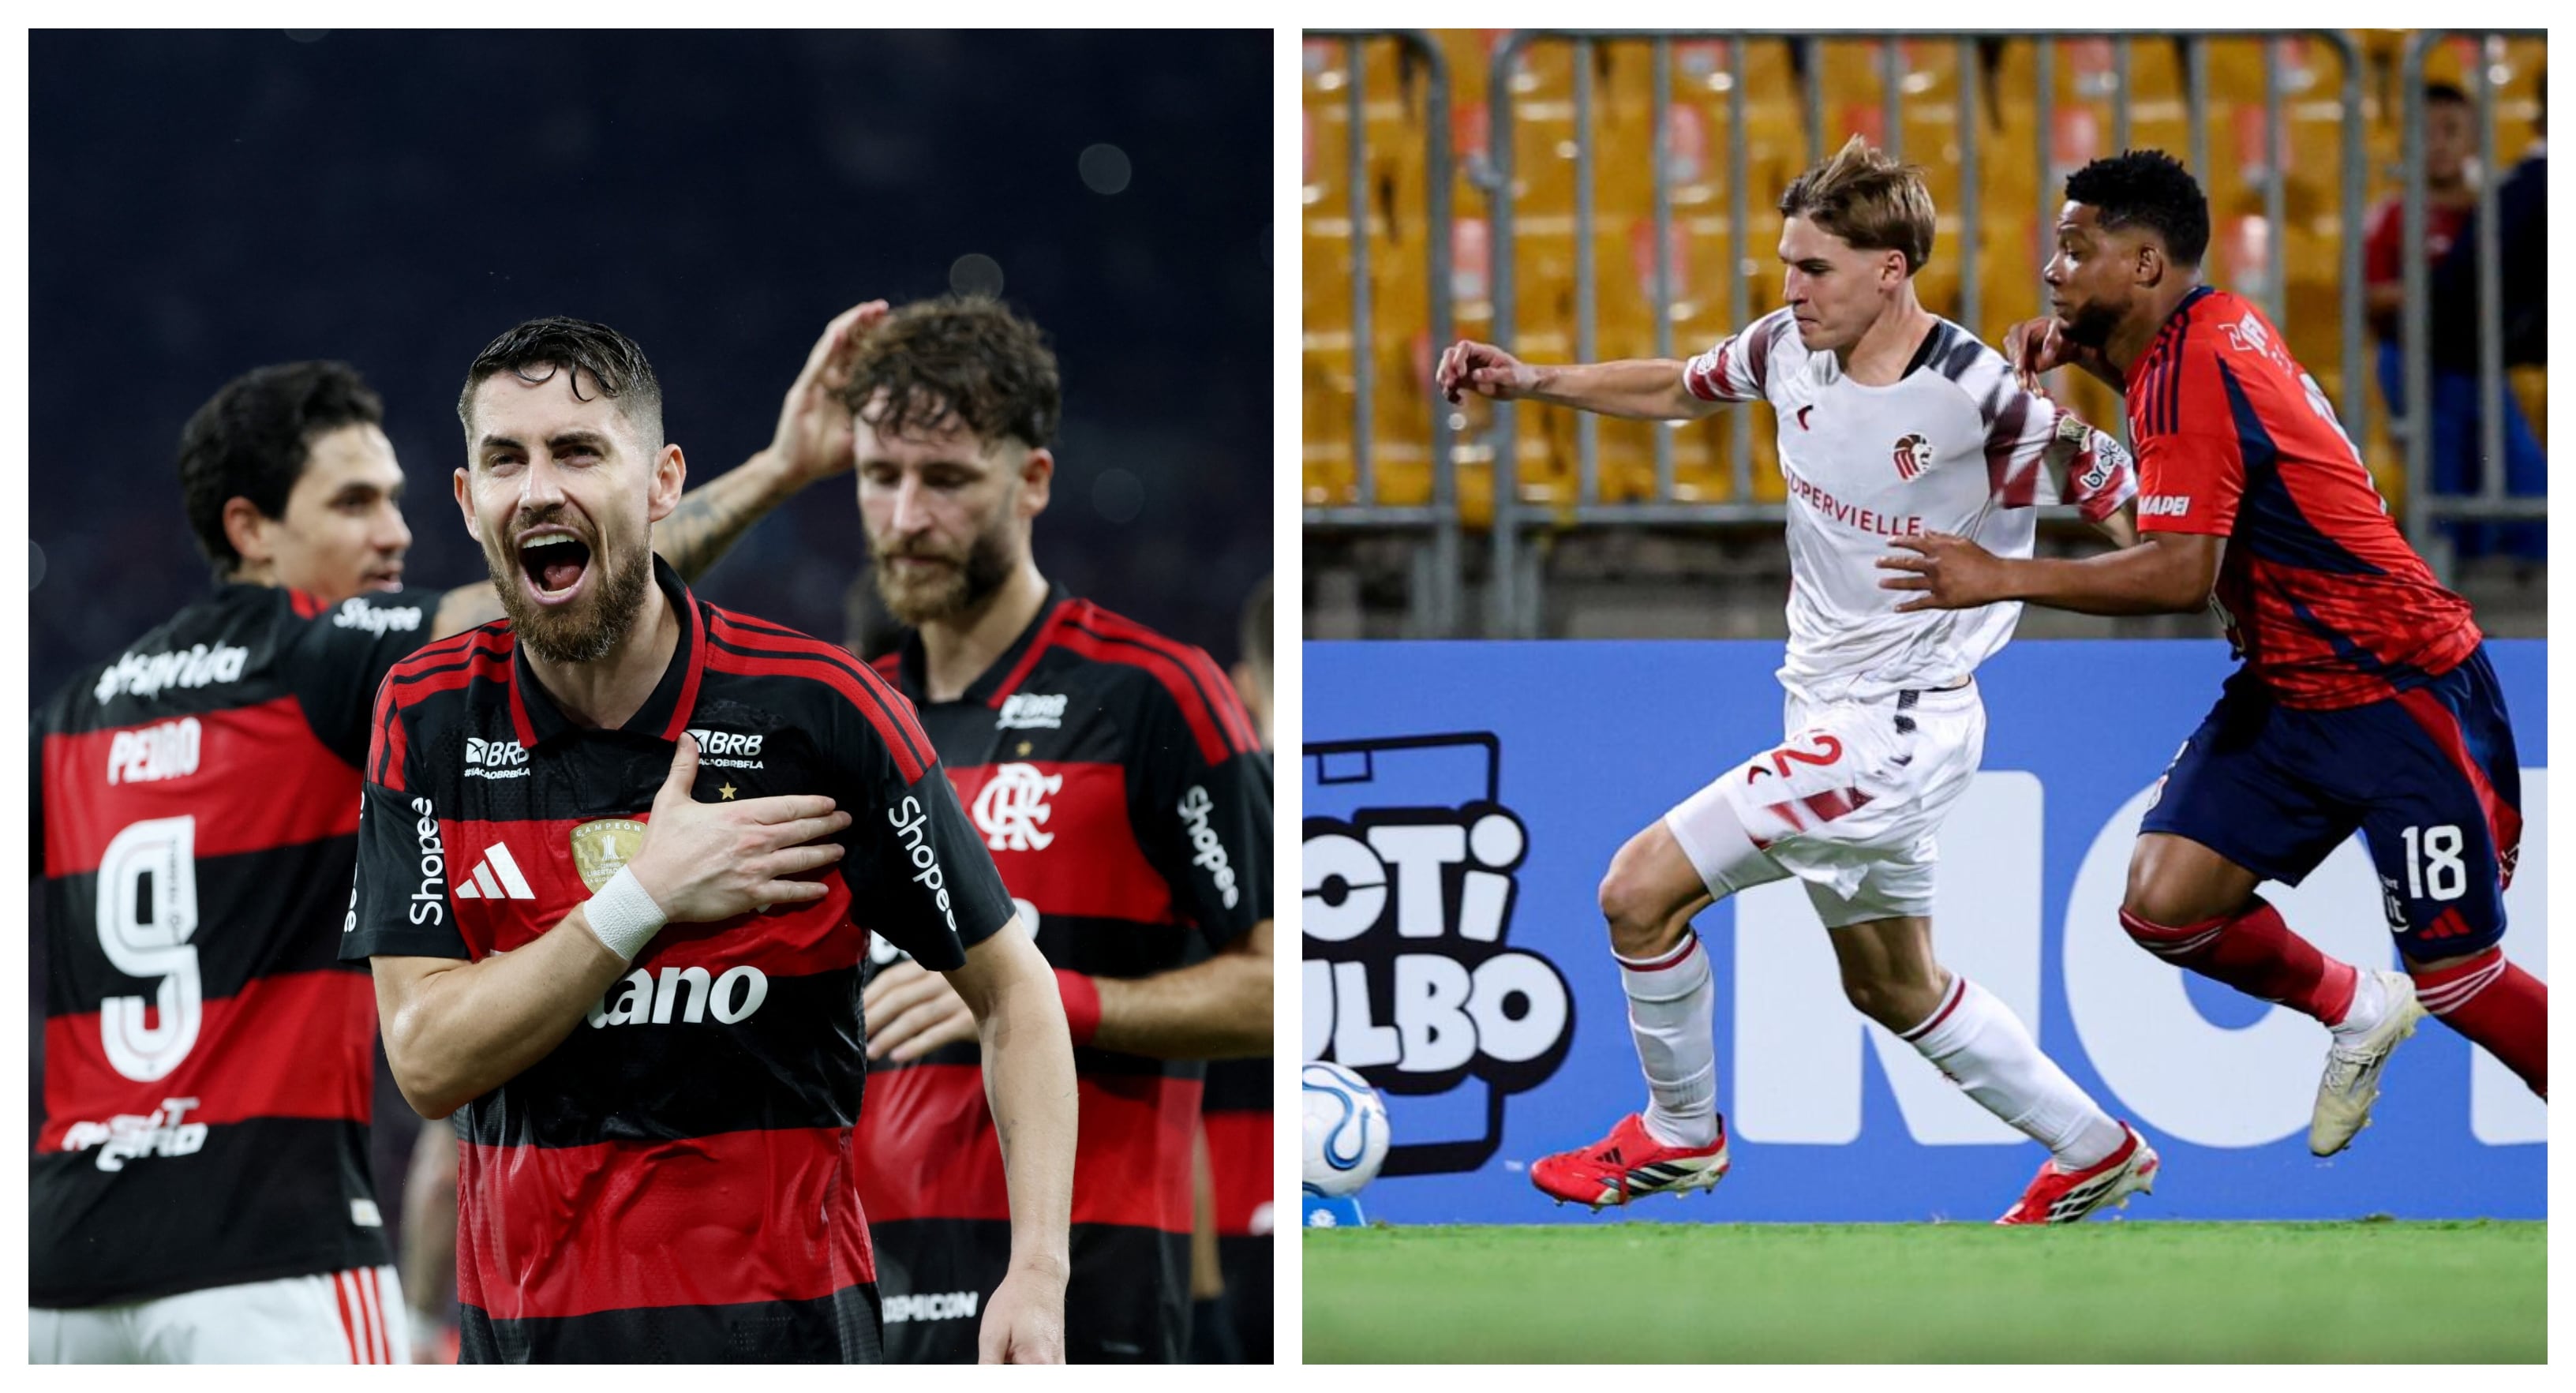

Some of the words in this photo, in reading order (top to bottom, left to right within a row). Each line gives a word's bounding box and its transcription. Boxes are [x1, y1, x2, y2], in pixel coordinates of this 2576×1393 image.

[486, 738, 530, 767] BRB
[710, 731, 763, 756] BRB
[1771, 728, 1843, 779] 2
[409, 796, 444, 927] Shopee
[576, 822, 641, 837] CAMPEÓN
[888, 796, 957, 932] Shopee
[1177, 784, 1239, 910] Shopee
[2401, 824, 2467, 901] 18
[586, 867, 619, 878] LIBERTAD
[95, 814, 204, 1084] 9
[1734, 769, 2548, 1148] NO
